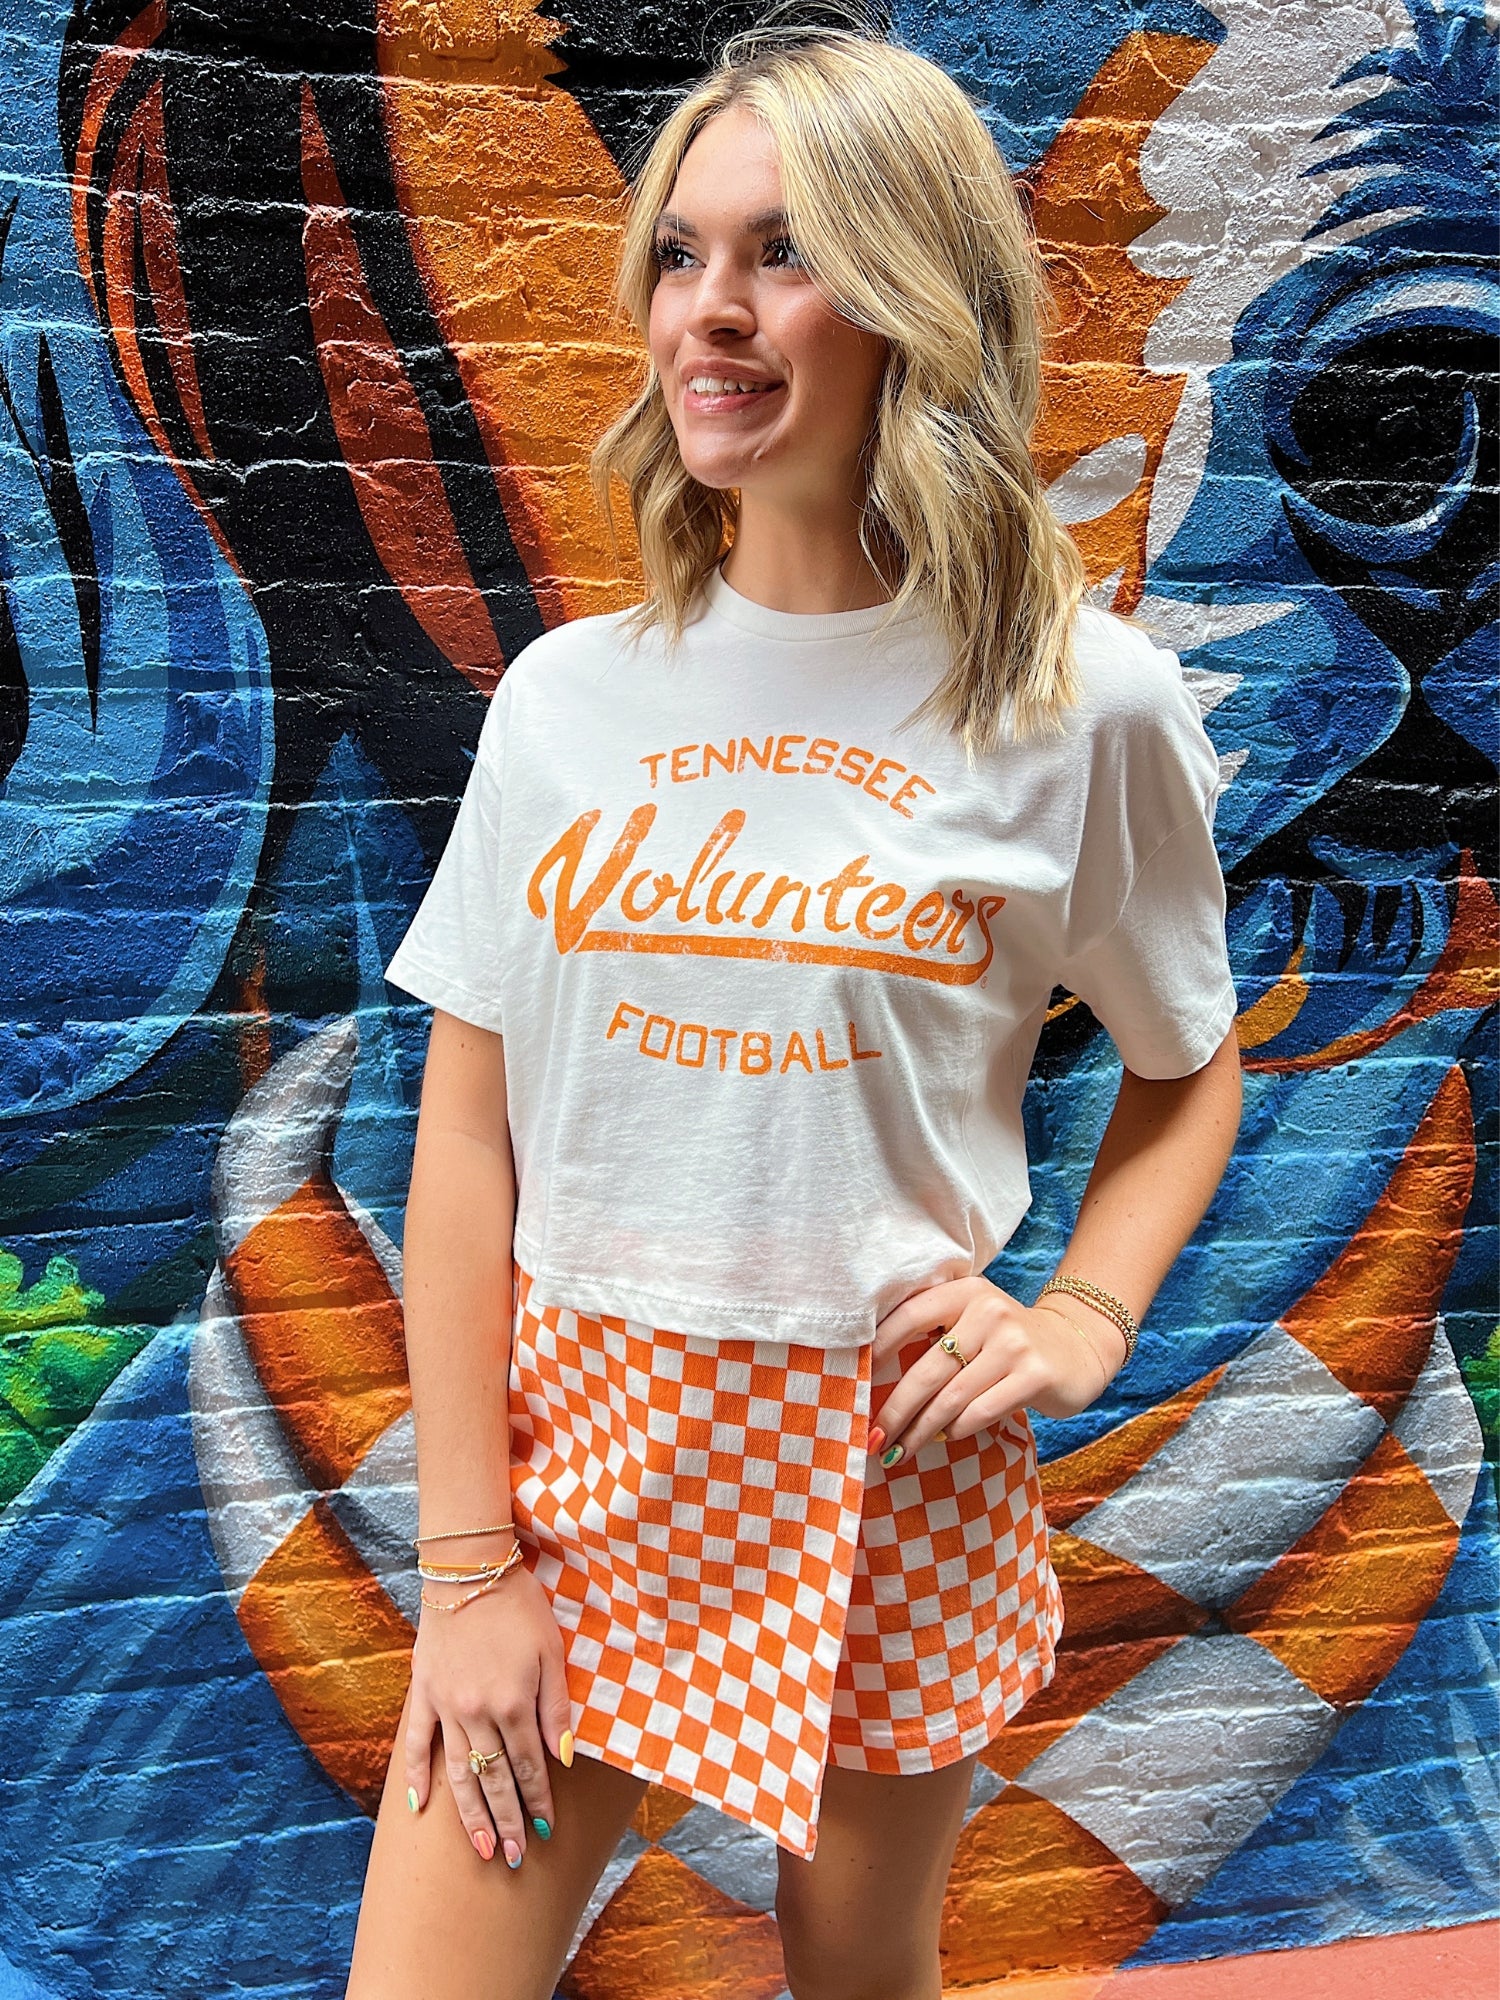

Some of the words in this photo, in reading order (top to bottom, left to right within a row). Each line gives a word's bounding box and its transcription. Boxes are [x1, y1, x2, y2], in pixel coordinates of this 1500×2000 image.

[639, 735, 937, 819] TENNESSEE
[527, 803, 1007, 986] Volunteers
[606, 1001, 882, 1076] FOOTBALL
